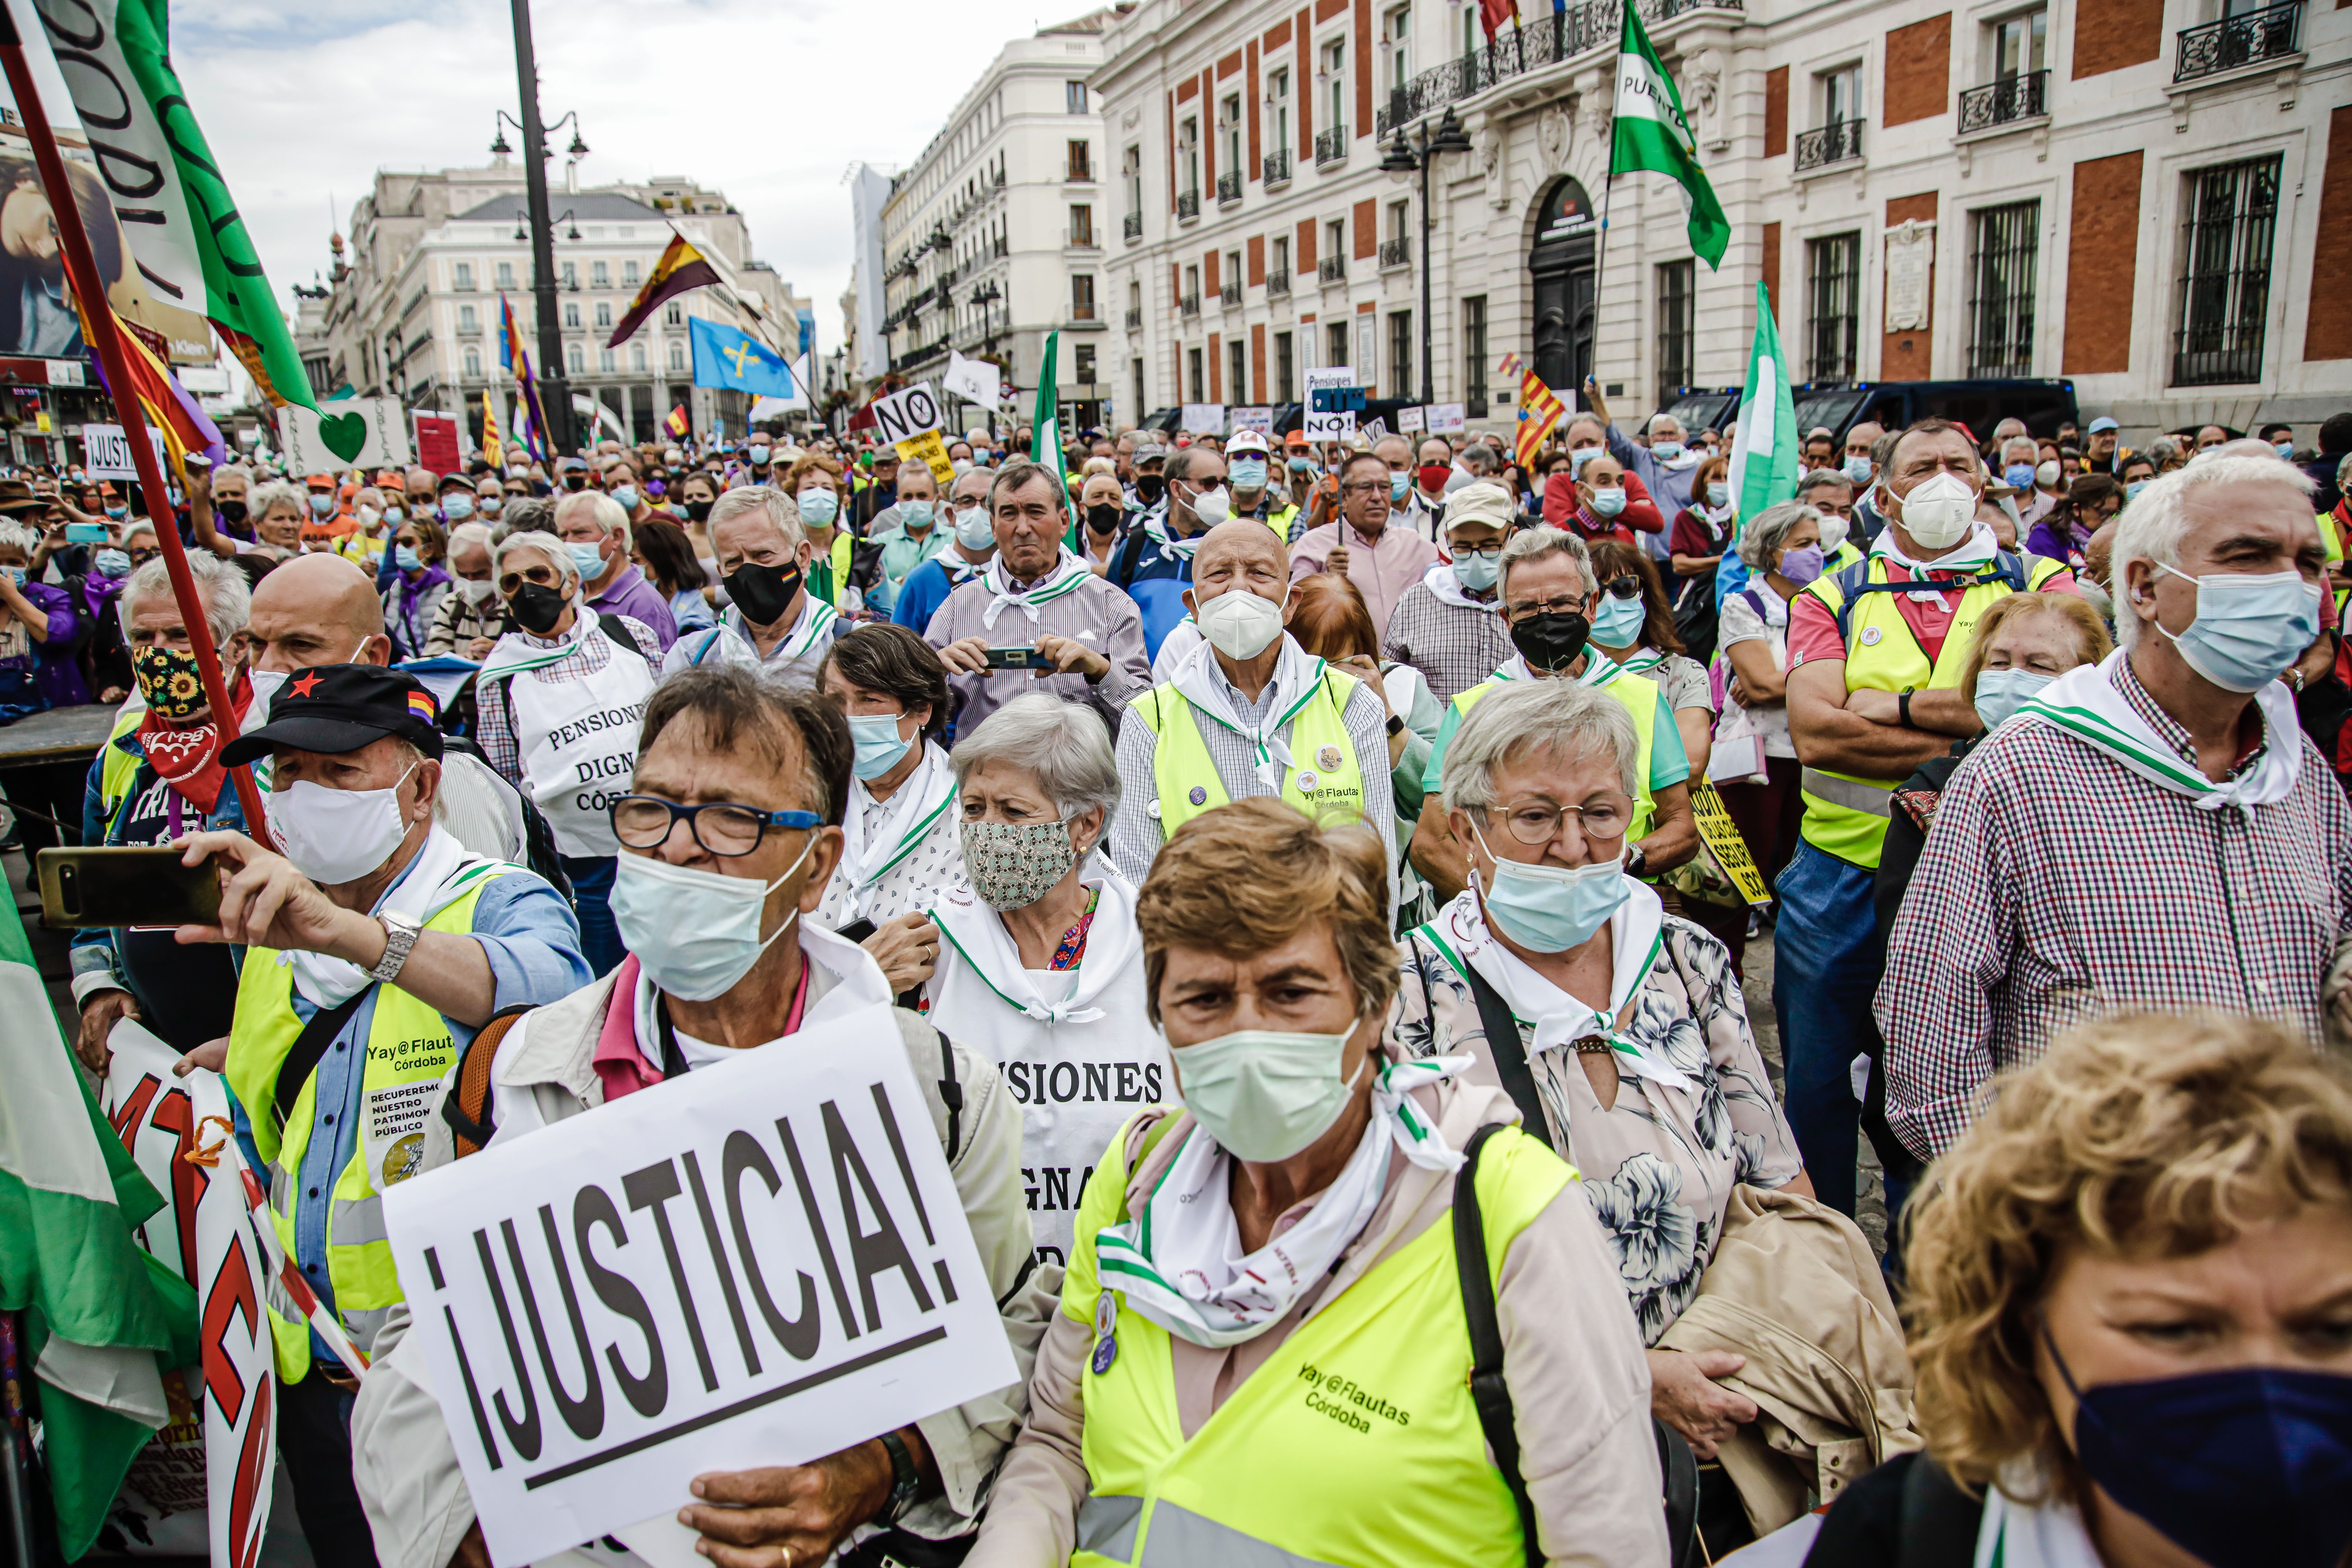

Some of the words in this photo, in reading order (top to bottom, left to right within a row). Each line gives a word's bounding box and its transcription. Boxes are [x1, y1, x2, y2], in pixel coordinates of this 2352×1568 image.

[175, 339, 207, 356] Klein
[875, 389, 937, 442] NO
[1308, 416, 1351, 432] NO!
[168, 729, 204, 742] MPB
[576, 752, 635, 782] DIGN
[1303, 787, 1358, 801] y@Flautas
[394, 1055, 446, 1072] Córdoba
[998, 1062, 1162, 1104] SIONES
[372, 1098, 421, 1114] NUESTRO
[373, 1110, 430, 1126] PATRIMON
[374, 1121, 423, 1138] PÚBLICO
[424, 1081, 959, 1470] ¡JUSTICIA!
[1298, 1362, 1410, 1427] Yay@Flautas
[1305, 1391, 1370, 1434] Córdoba
